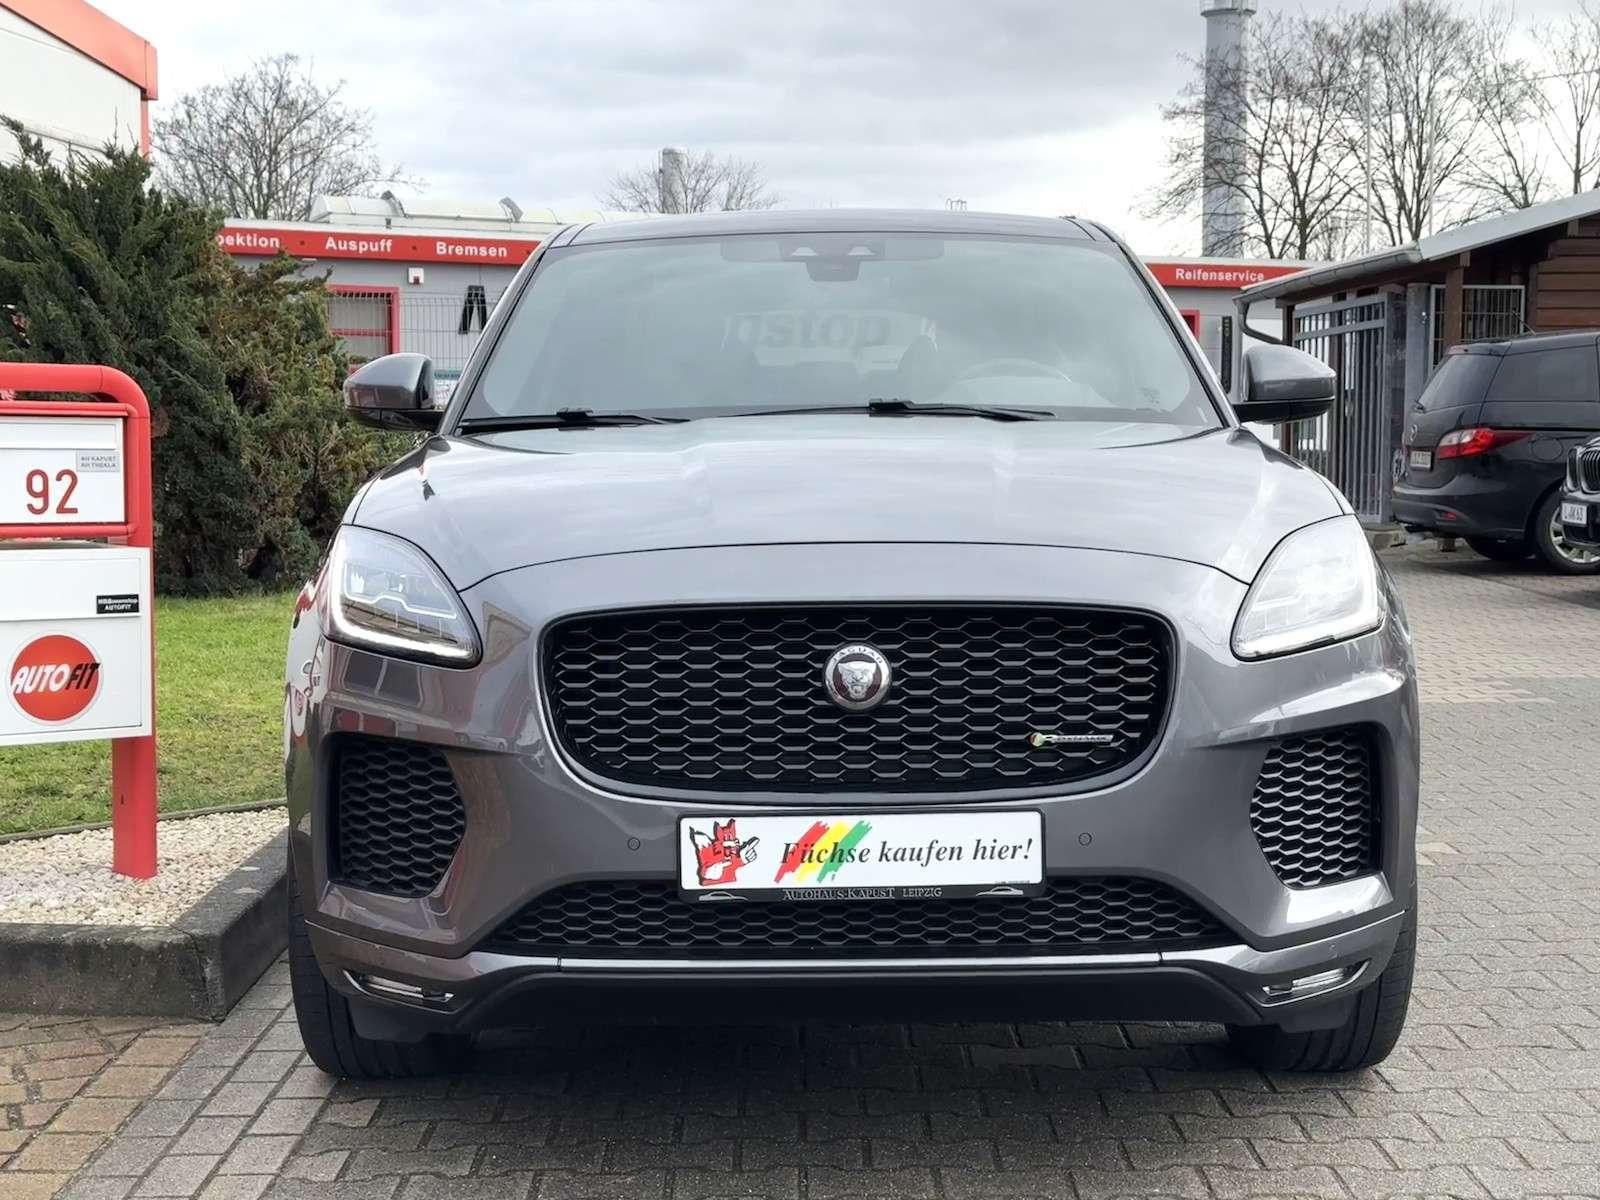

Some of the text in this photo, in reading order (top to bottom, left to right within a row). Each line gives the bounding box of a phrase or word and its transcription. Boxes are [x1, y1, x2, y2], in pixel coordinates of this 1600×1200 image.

[325, 236, 393, 253] Auspuff
[436, 241, 508, 258] Bremsen
[1175, 267, 1265, 283] Reifenservice
[26, 469, 79, 515] 92
[11, 662, 101, 695] AUTOFIT
[781, 838, 1033, 867] Füchse kaufen hier!
[902, 887, 943, 898] LEIPZIG
